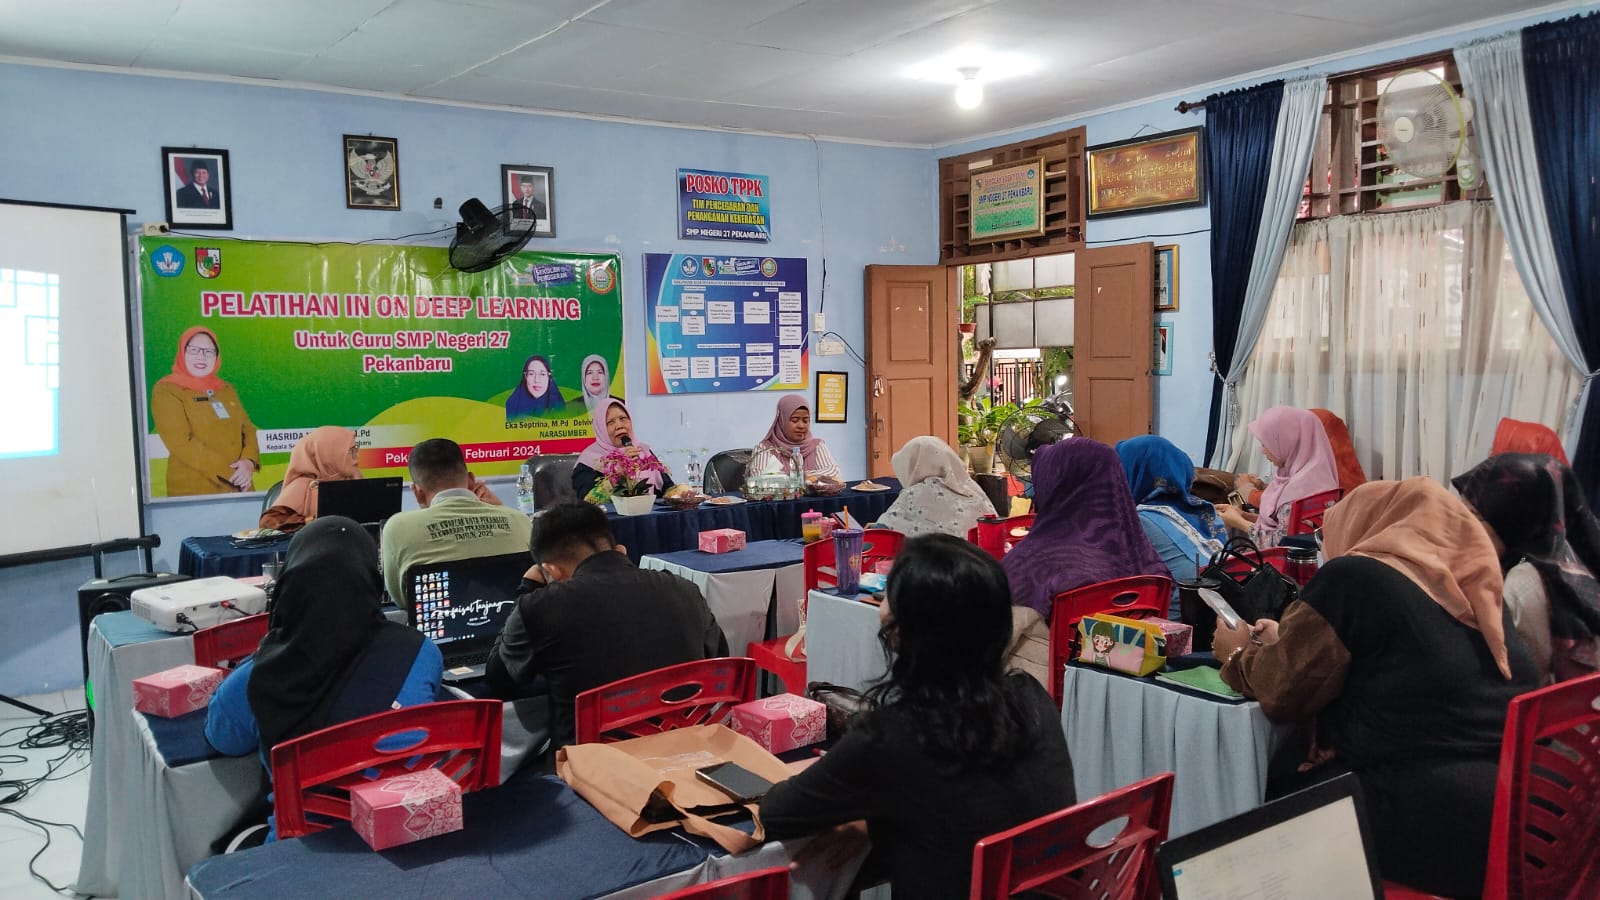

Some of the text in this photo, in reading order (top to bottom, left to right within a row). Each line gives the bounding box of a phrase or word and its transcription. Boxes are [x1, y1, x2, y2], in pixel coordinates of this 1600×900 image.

[686, 174, 762, 197] POSKO TPPK
[692, 199, 705, 209] TIM
[746, 203, 759, 213] DAN
[687, 211, 765, 225] PENANGANAN KEKERASAN
[686, 228, 700, 236] SMP
[701, 229, 722, 237] NEGERI
[732, 230, 767, 239] PEKANBARU
[202, 292, 581, 319] PELATIHAN IN ON DEEP LEARNING
[296, 331, 509, 351] Untuk Guru SMP Negeri 27
[364, 355, 452, 372] Pekanbaru
[519, 421, 550, 429] Septrina,
[551, 419, 569, 427] M.Pd
[266, 431, 304, 441] HASRIDA
[539, 429, 587, 438] NARASUMBER
[266, 443, 287, 451] Kepala
[385, 445, 541, 464] Pek Februari 2024
